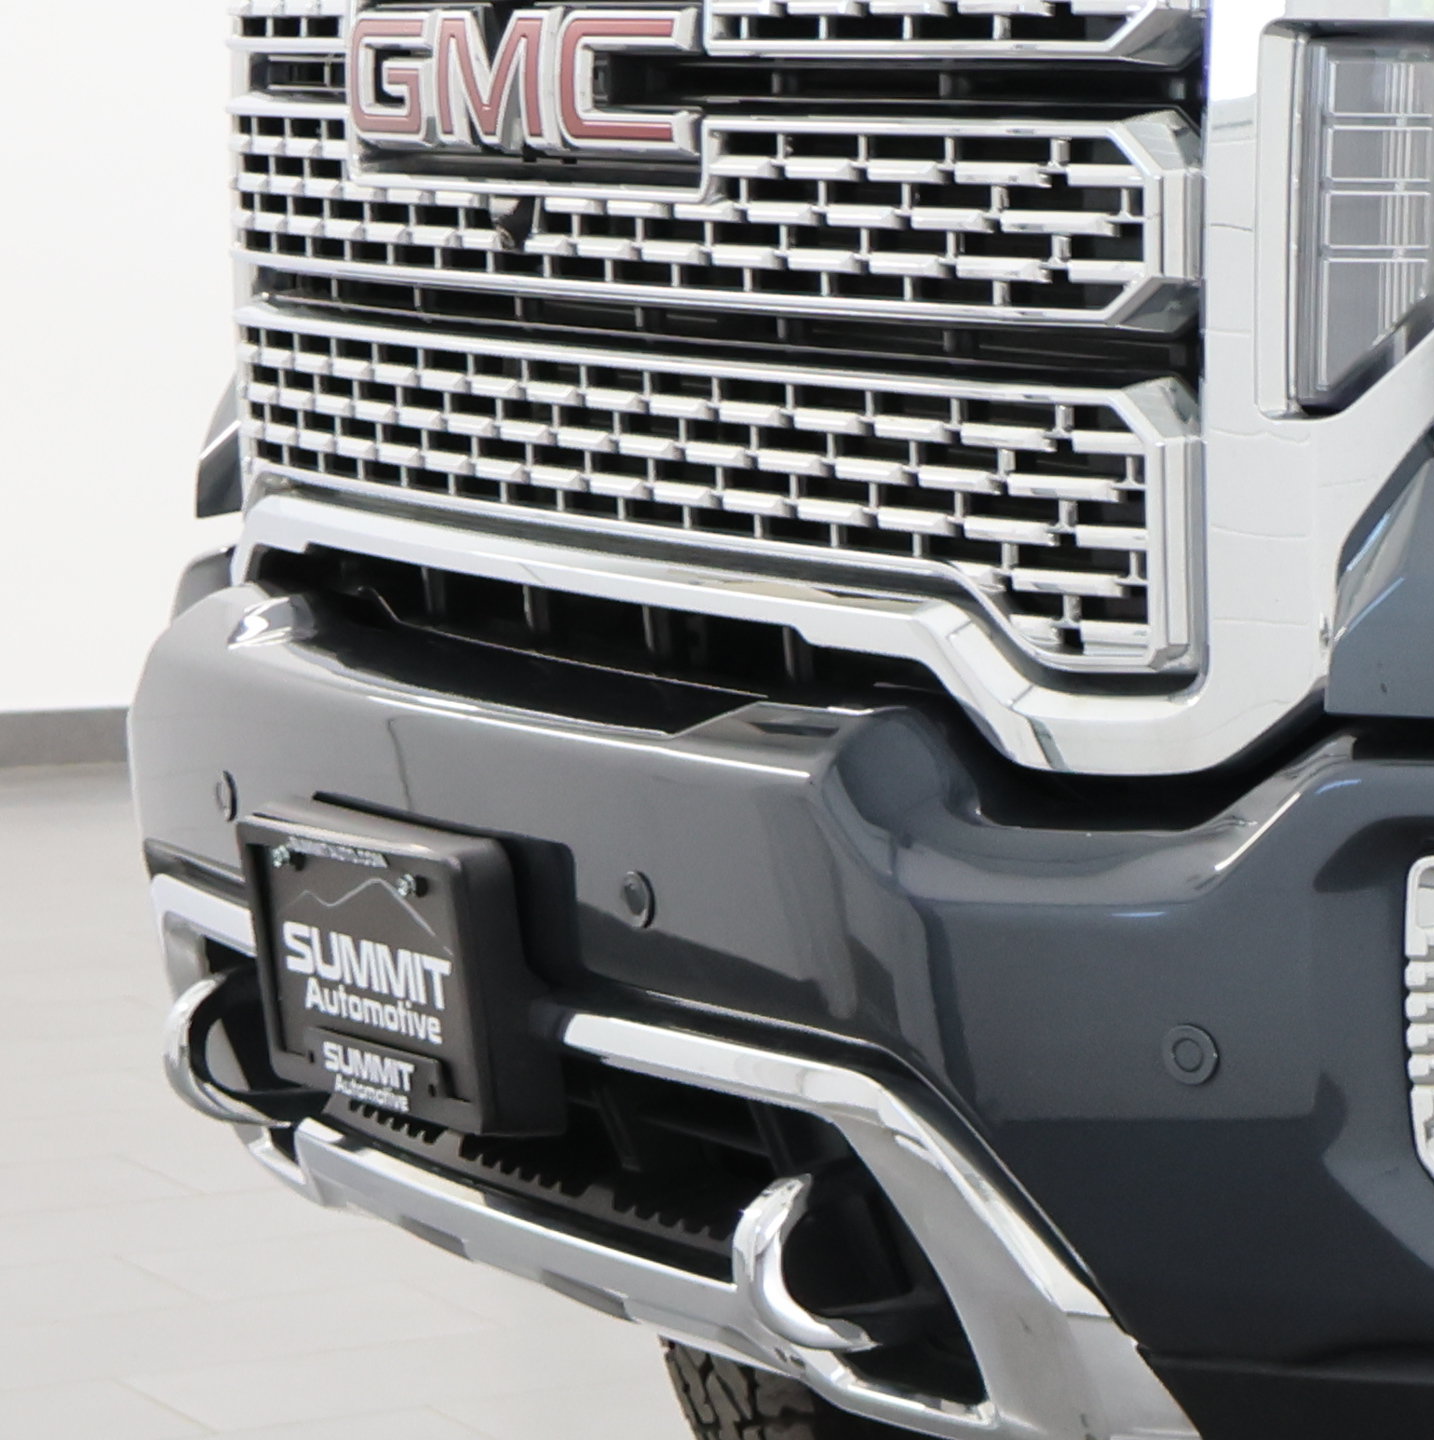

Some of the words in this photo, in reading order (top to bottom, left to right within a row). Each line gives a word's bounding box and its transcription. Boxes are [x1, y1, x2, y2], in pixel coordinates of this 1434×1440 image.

[350, 8, 700, 155] GMC
[282, 921, 453, 1010] SUMMIT
[304, 975, 444, 1045] Automotive
[323, 1040, 415, 1093] SUMMIT
[334, 1072, 410, 1112] Automotive
